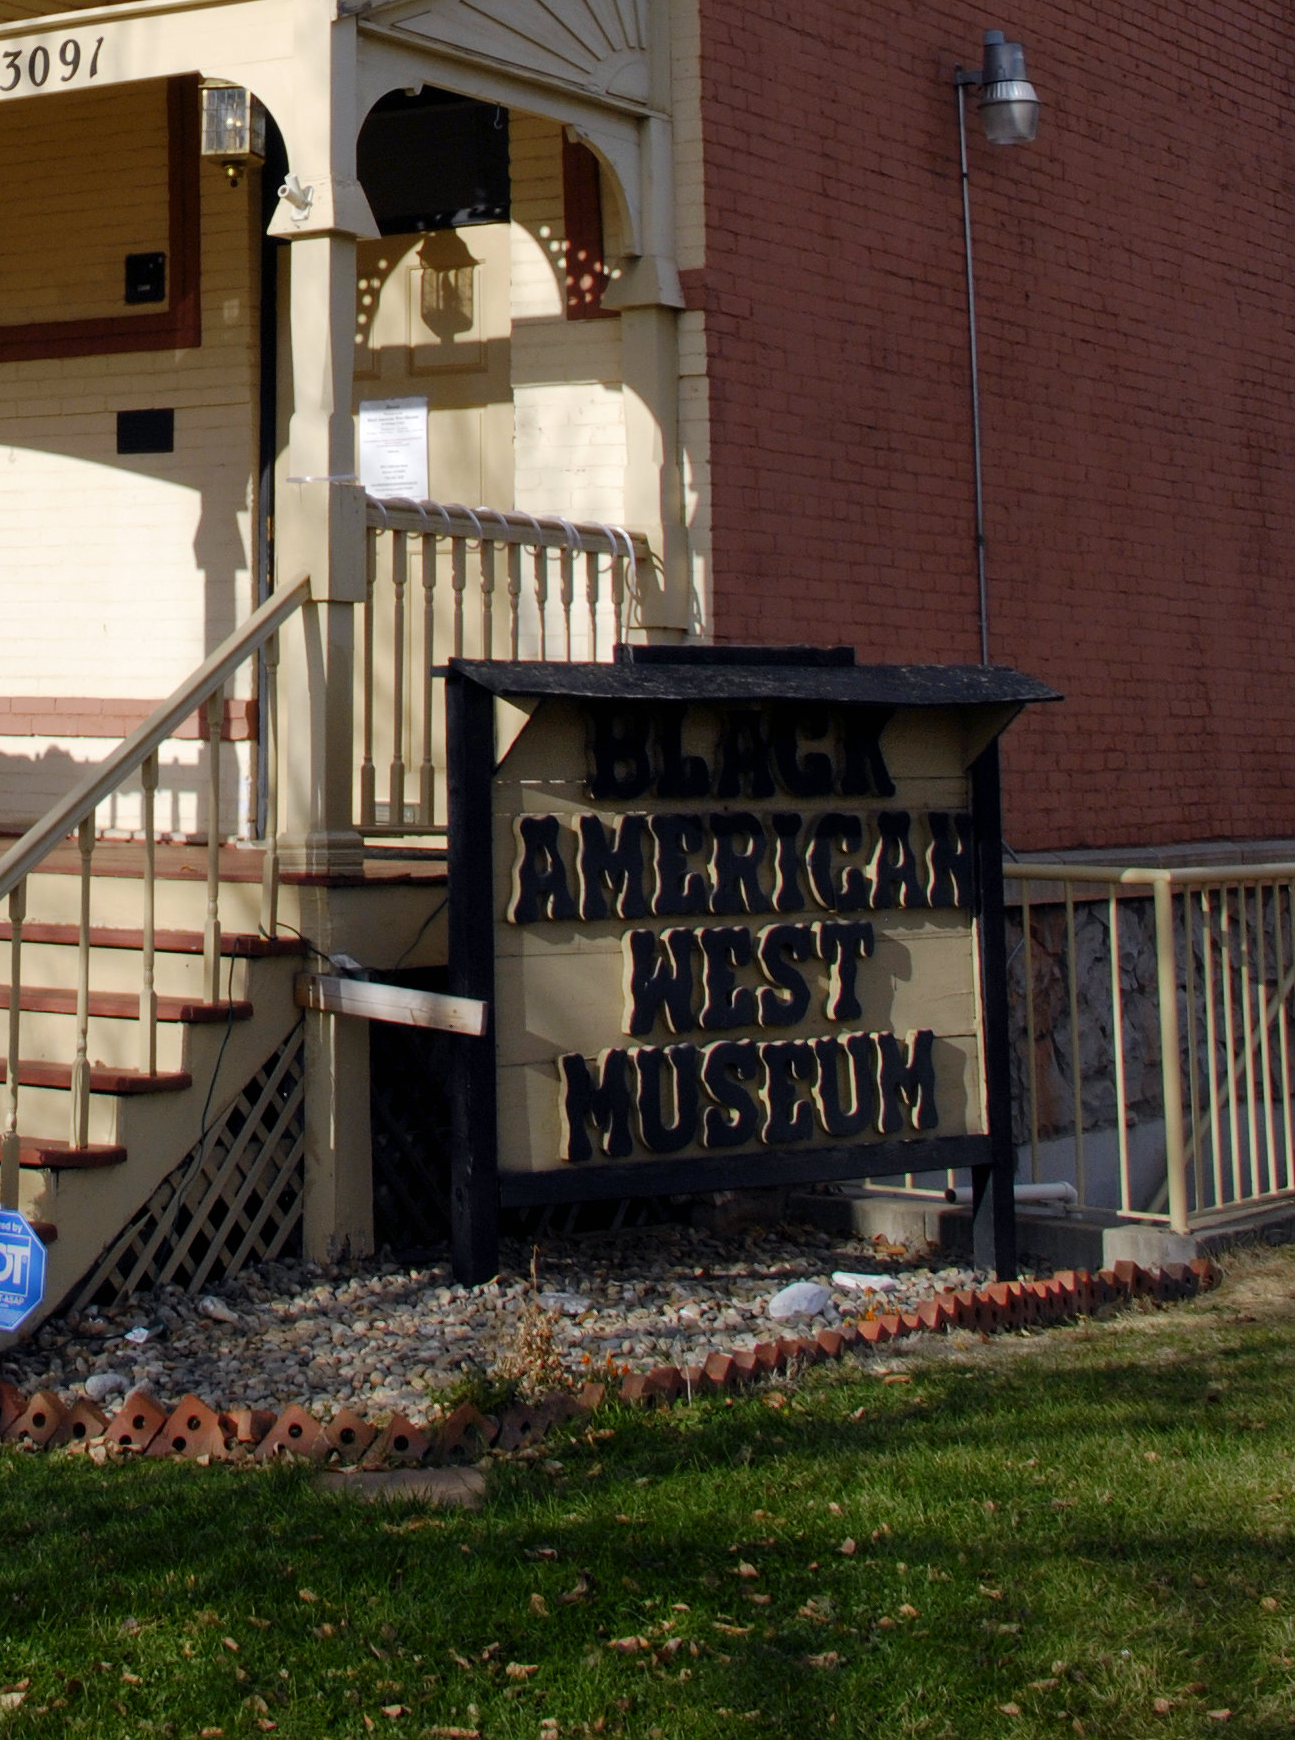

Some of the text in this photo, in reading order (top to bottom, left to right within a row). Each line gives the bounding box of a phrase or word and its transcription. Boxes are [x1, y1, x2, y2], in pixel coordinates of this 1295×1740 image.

[0, 36, 104, 91] 3091
[587, 702, 896, 798] BLACK
[510, 811, 971, 922] AMERICAN
[621, 921, 874, 1035] WEST
[561, 1029, 939, 1161] MUSEUM
[12, 1222, 23, 1234] by
